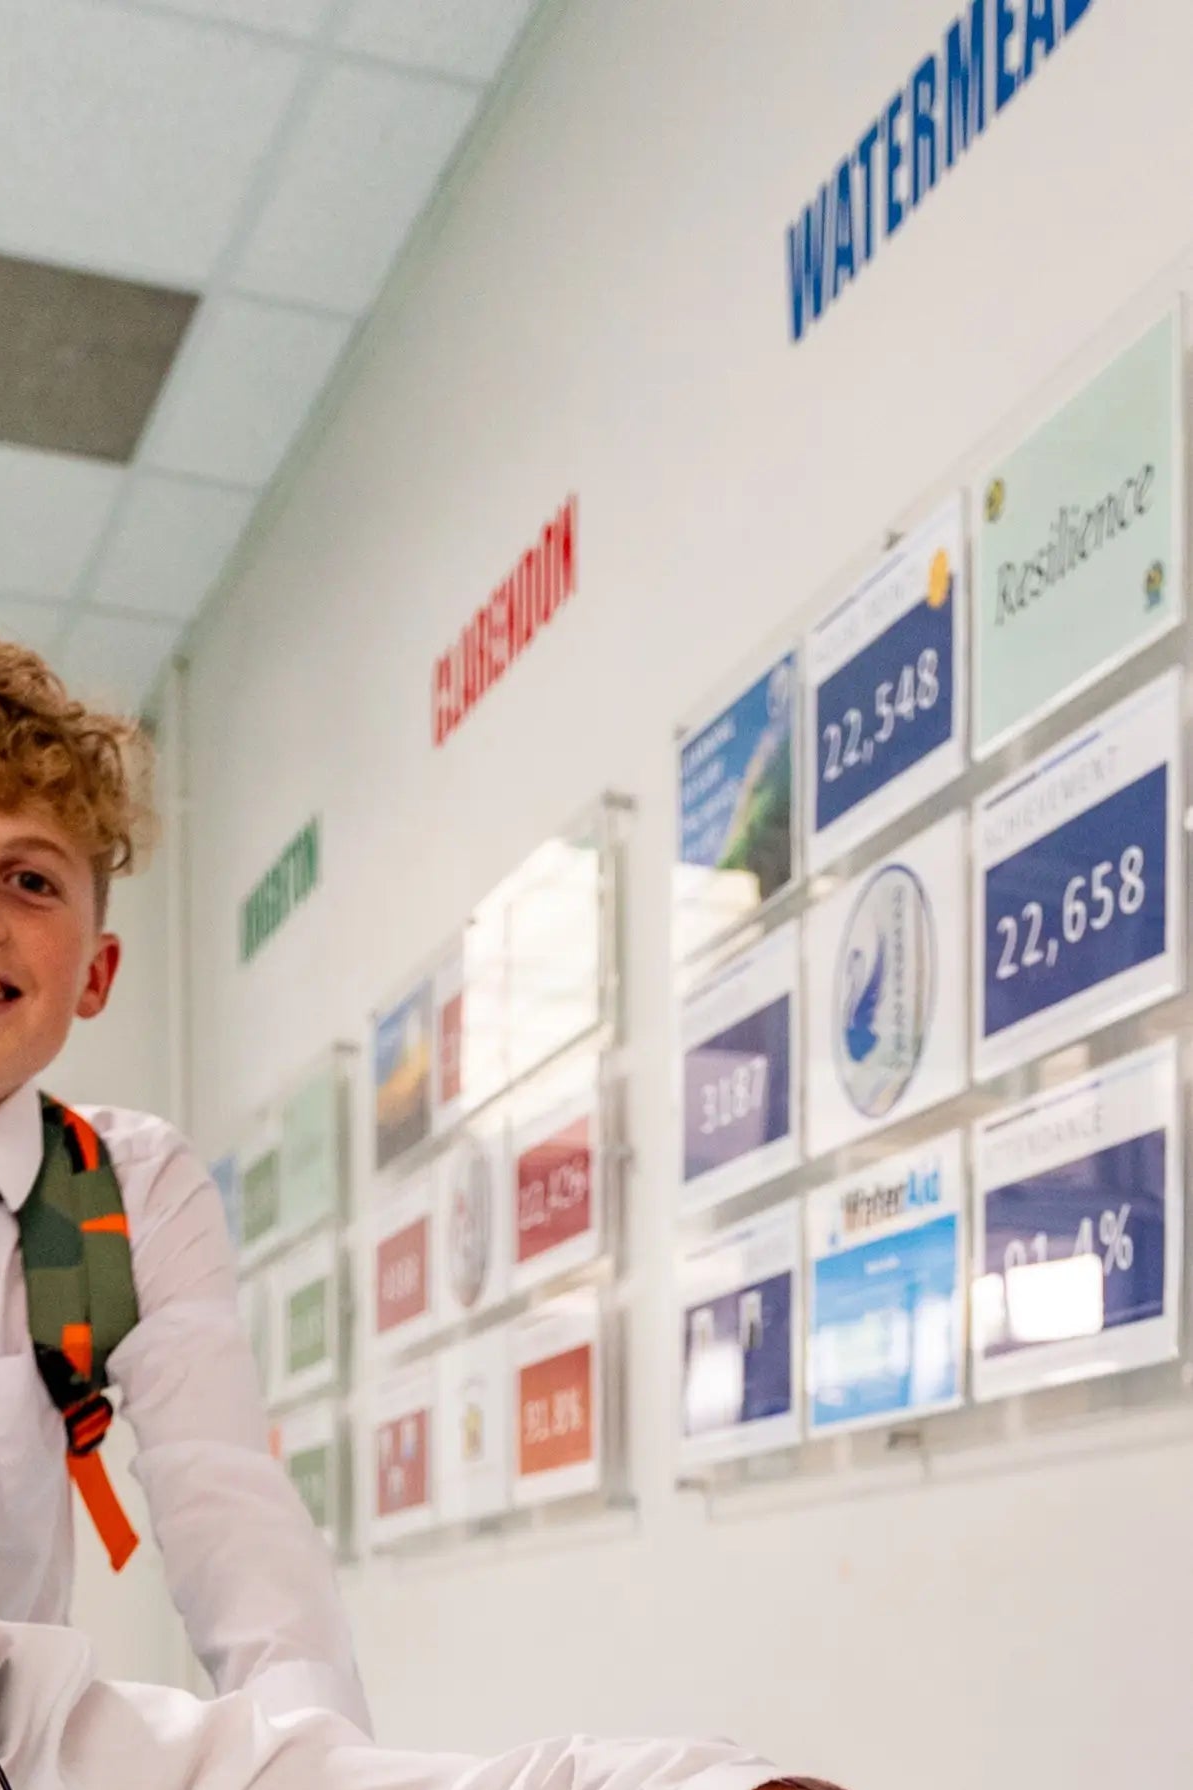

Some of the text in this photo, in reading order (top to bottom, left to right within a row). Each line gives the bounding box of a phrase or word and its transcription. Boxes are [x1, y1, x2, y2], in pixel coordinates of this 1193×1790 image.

[786, 0, 1096, 343] WATERMEA
[822, 648, 940, 783] 22,548
[995, 844, 1146, 981] 22,658
